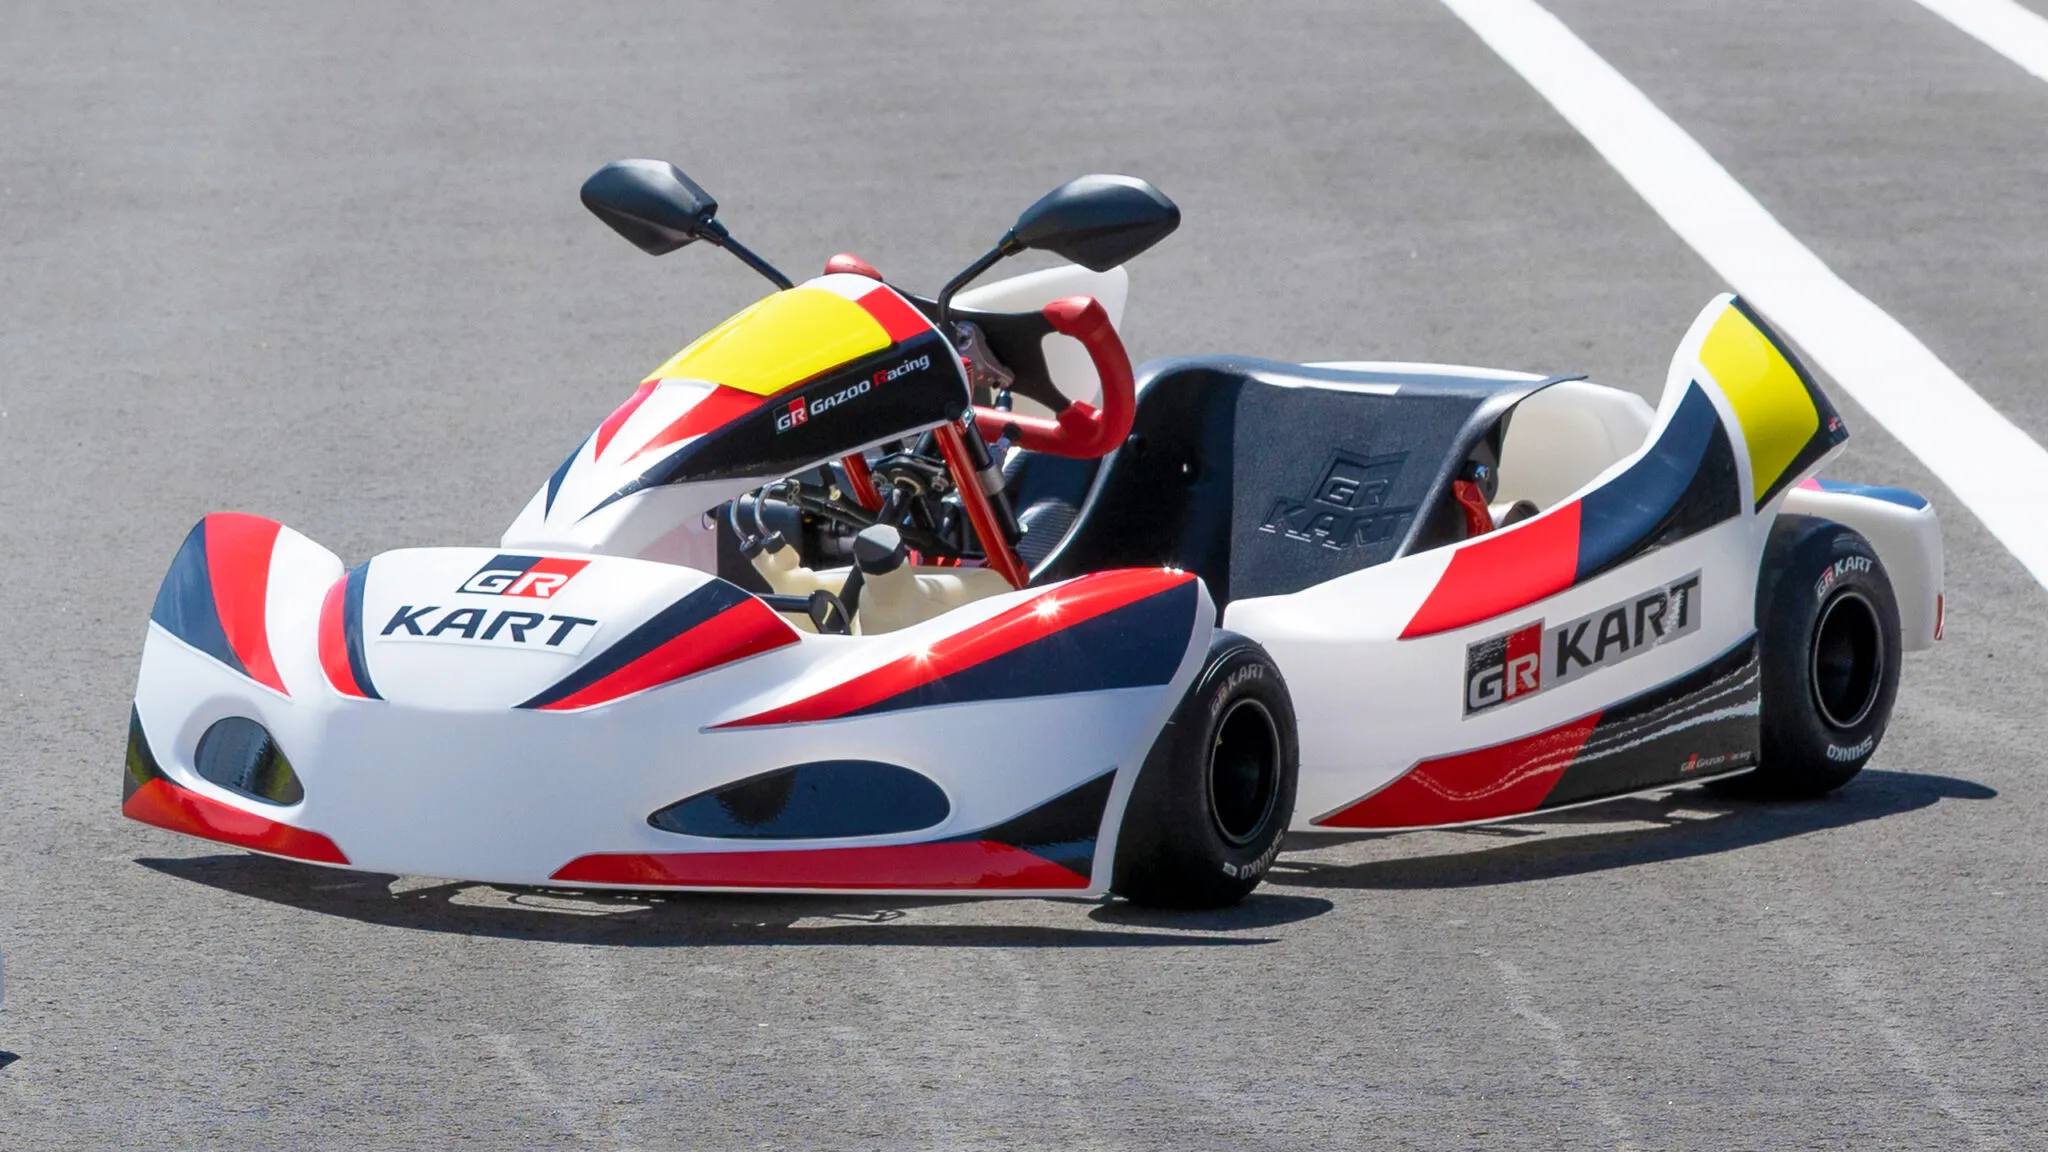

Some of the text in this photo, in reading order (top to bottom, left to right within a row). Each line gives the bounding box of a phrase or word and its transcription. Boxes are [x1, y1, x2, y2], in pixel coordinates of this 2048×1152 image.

[777, 354, 930, 430] GR GAZOO Racing
[1834, 555, 1873, 577] KART
[463, 569, 569, 597] GR
[380, 605, 598, 646] KART
[1469, 576, 1698, 708] GR KART
[1227, 663, 1265, 691] KART
[1826, 734, 1873, 762] SHINKO
